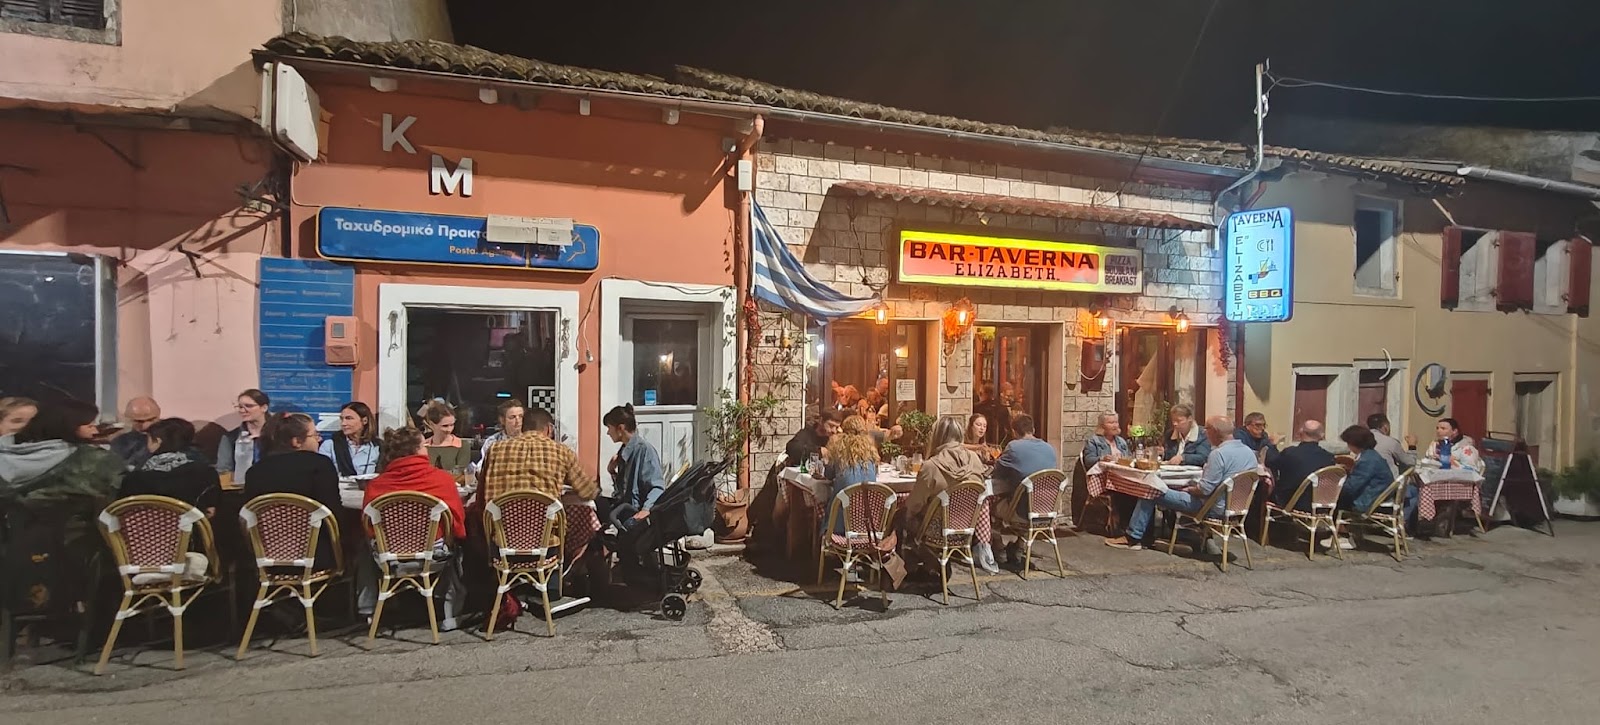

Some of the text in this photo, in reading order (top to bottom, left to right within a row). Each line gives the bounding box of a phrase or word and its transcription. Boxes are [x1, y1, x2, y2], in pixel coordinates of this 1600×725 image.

[382, 113, 417, 154] K
[431, 154, 473, 196] M
[334, 217, 434, 238] Ταχυδρομικό
[1232, 210, 1284, 232] TAVERNA
[910, 241, 1095, 270] BAR-TAVERNA
[1248, 289, 1281, 299] BBQ
